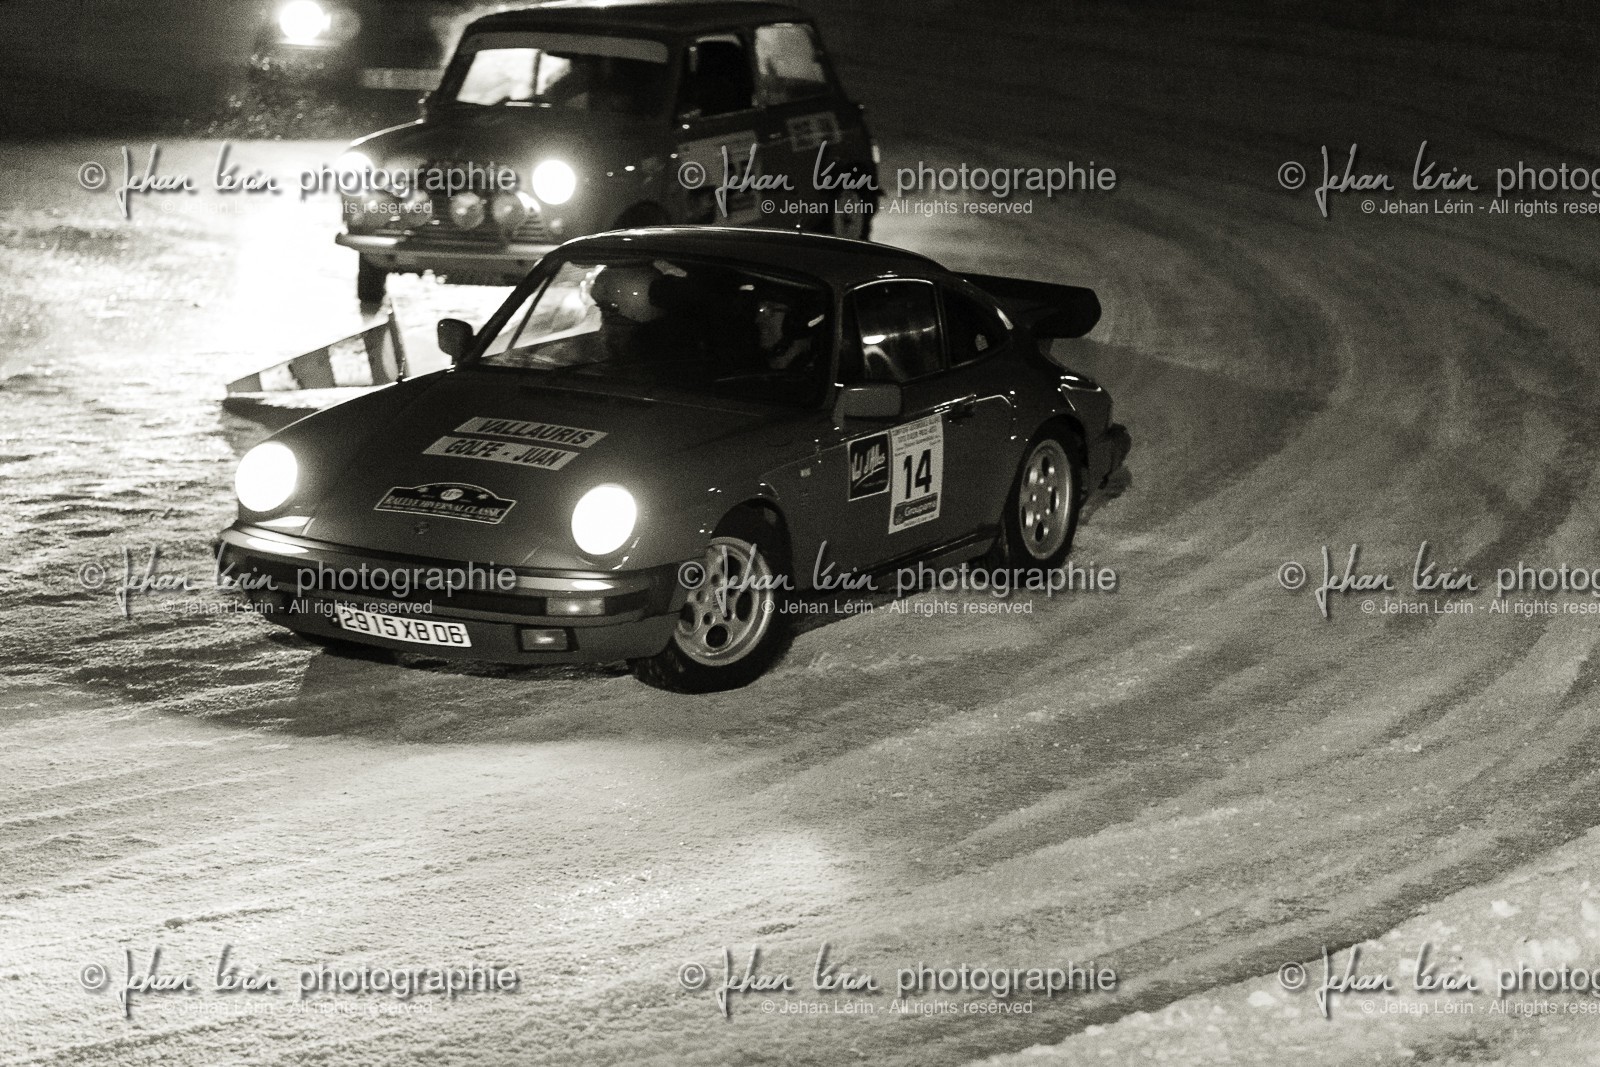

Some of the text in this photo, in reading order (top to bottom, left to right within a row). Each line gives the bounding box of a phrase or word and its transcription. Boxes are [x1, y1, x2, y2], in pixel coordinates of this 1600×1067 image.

[476, 420, 595, 445] VALLAURIS
[445, 438, 505, 458] GOLFE
[513, 447, 566, 467] JUAN
[903, 449, 933, 500] 14
